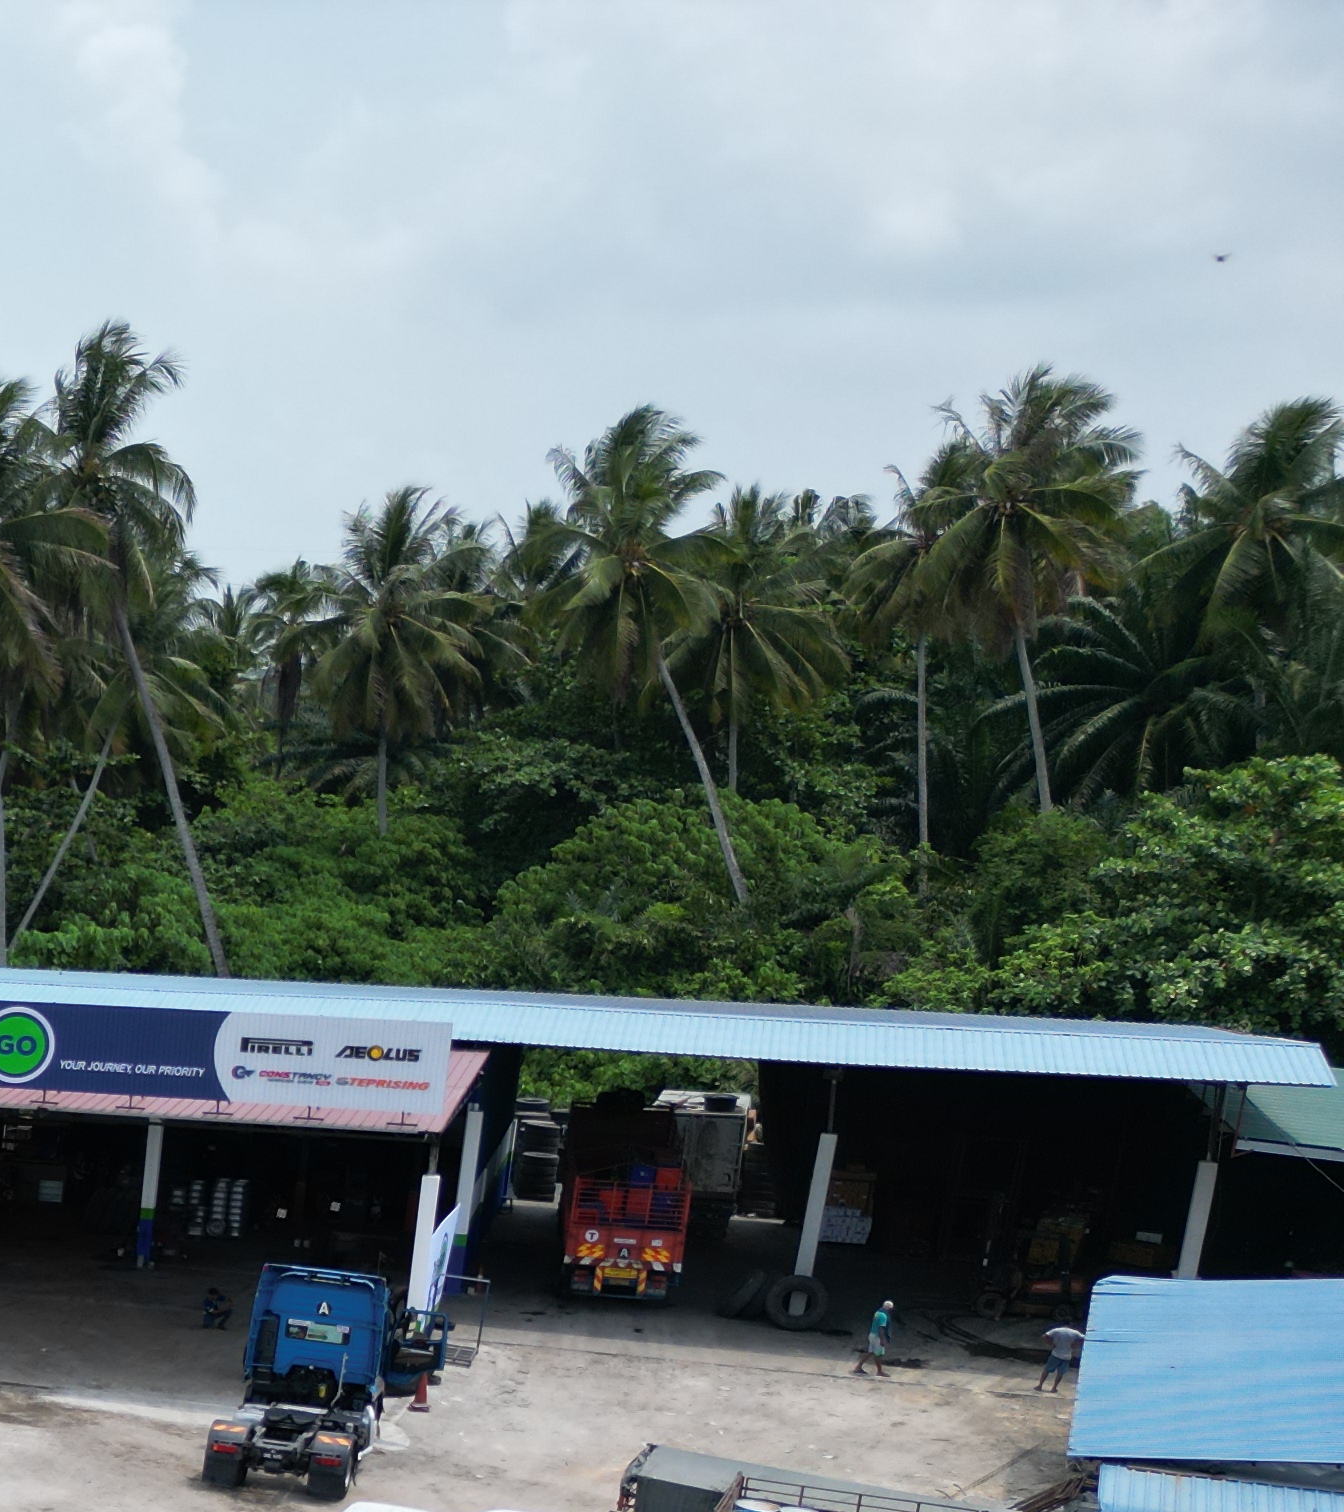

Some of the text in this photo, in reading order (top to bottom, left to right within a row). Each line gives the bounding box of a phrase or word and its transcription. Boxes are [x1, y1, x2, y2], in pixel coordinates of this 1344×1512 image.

[240, 1036, 423, 1063] PIRELLI AEOLUS
[60, 1059, 206, 1078] YOUR JOURNEY, OUR PRIORITY
[335, 1077, 431, 1091] STEPRISING
[318, 1301, 330, 1316] A
